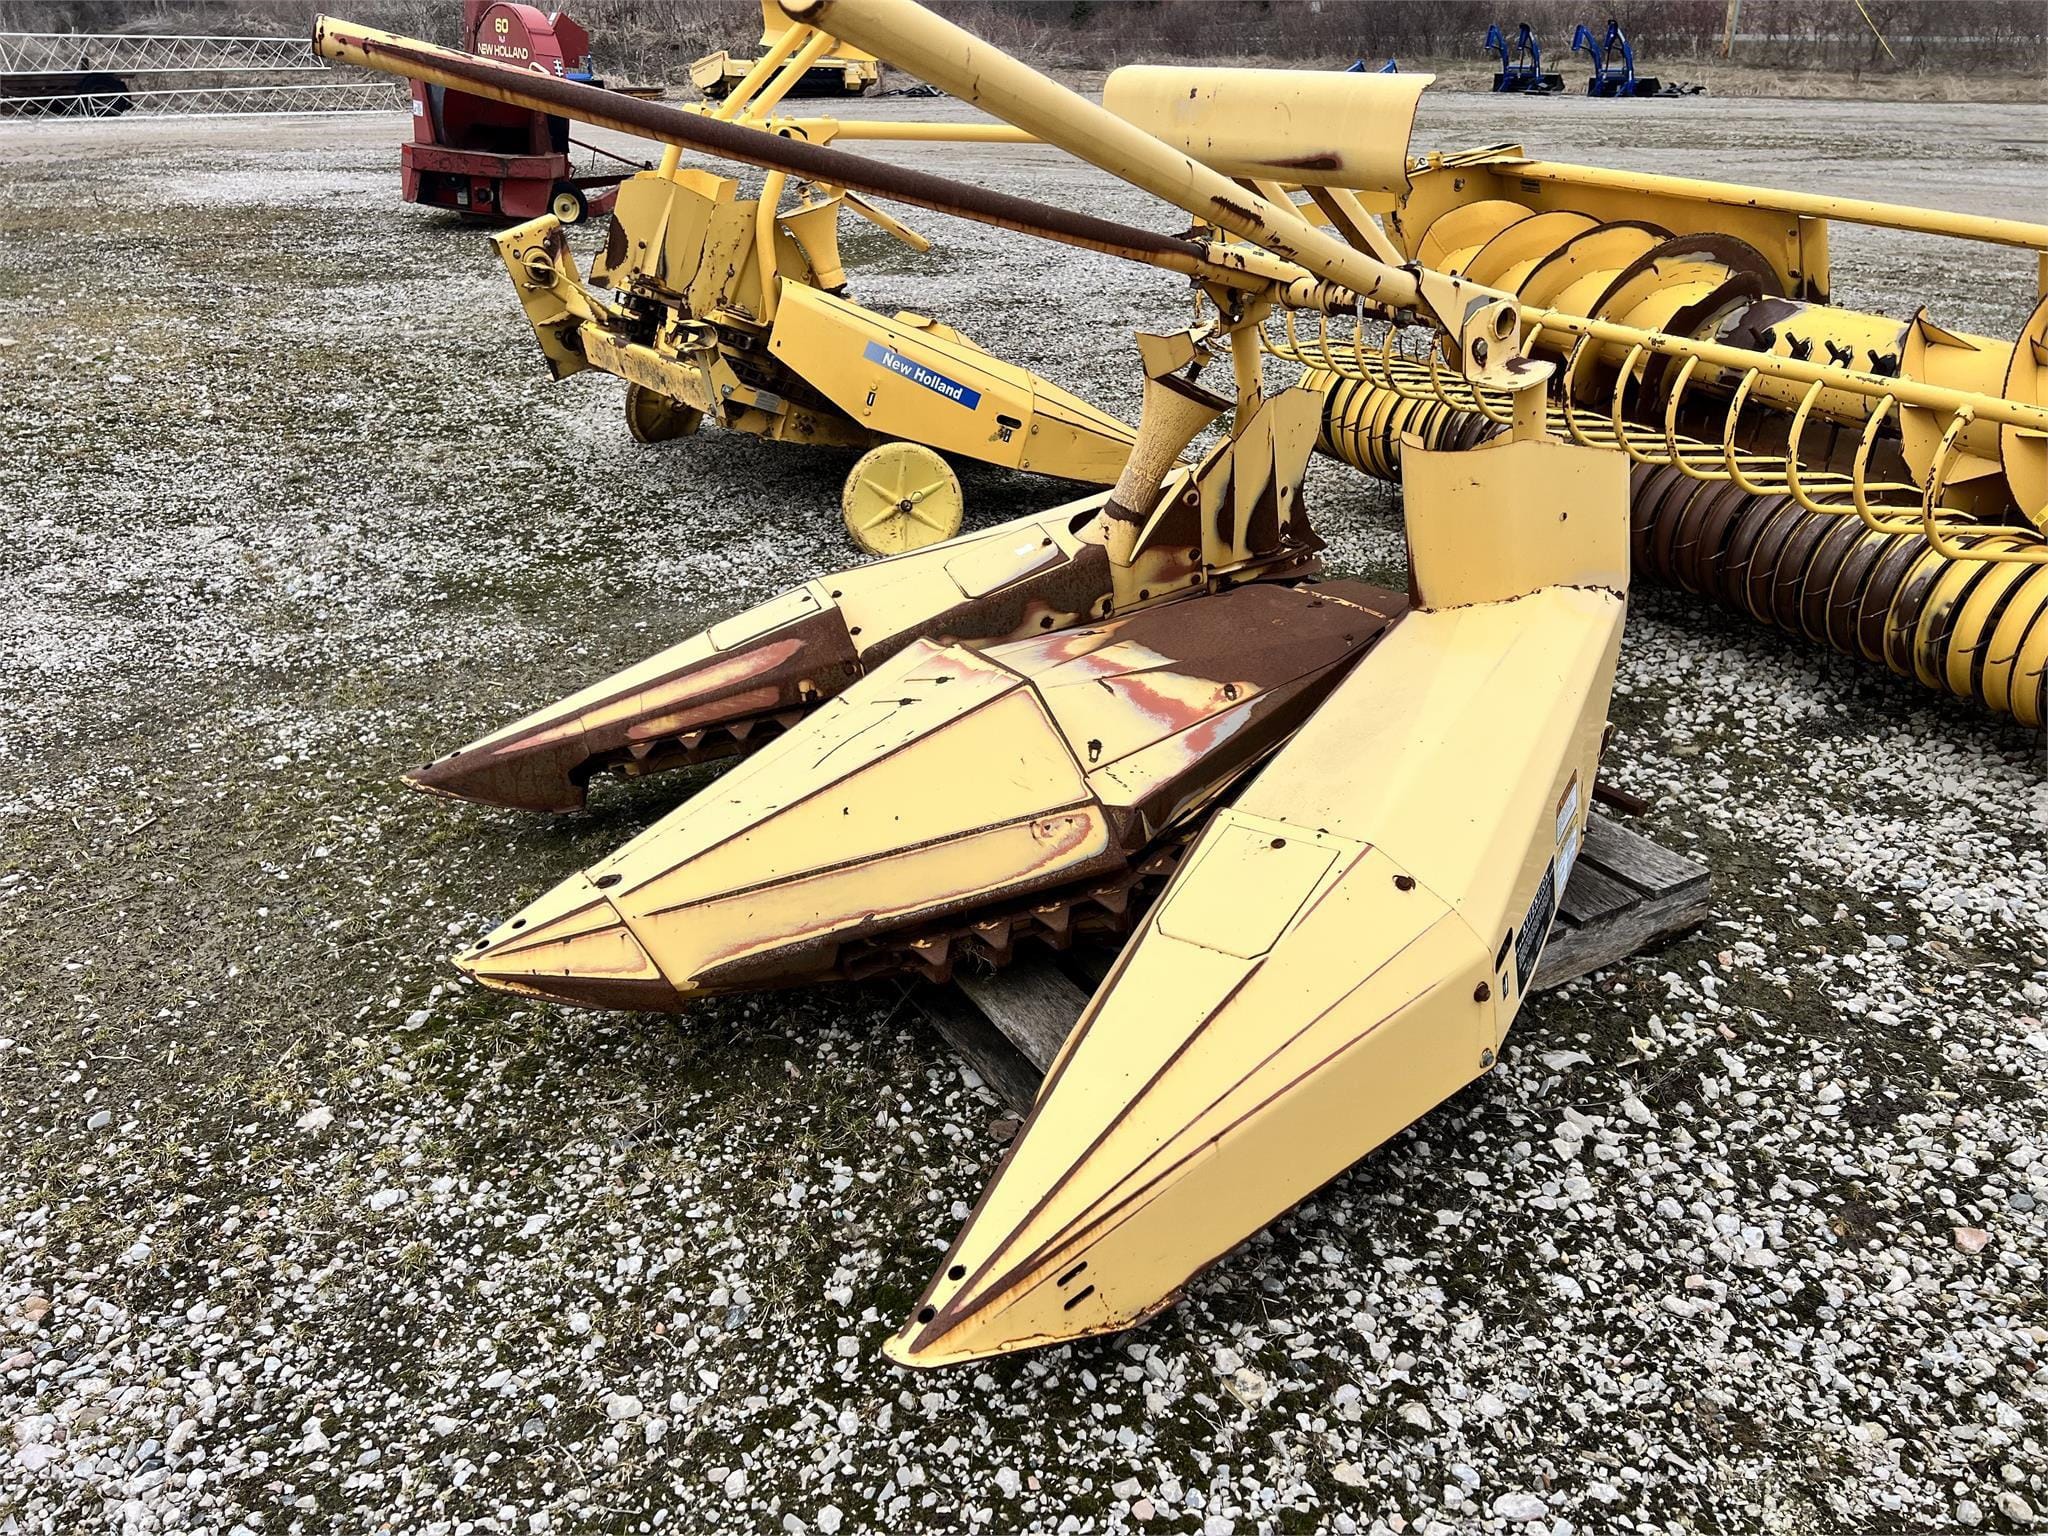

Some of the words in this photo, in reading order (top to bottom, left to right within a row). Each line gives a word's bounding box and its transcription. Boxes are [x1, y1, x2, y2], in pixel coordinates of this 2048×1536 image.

[495, 18, 509, 33] 60
[477, 42, 494, 55] NEW
[494, 44, 528, 60] HOLLAND
[882, 352, 912, 376] New
[913, 367, 963, 400] Holland
